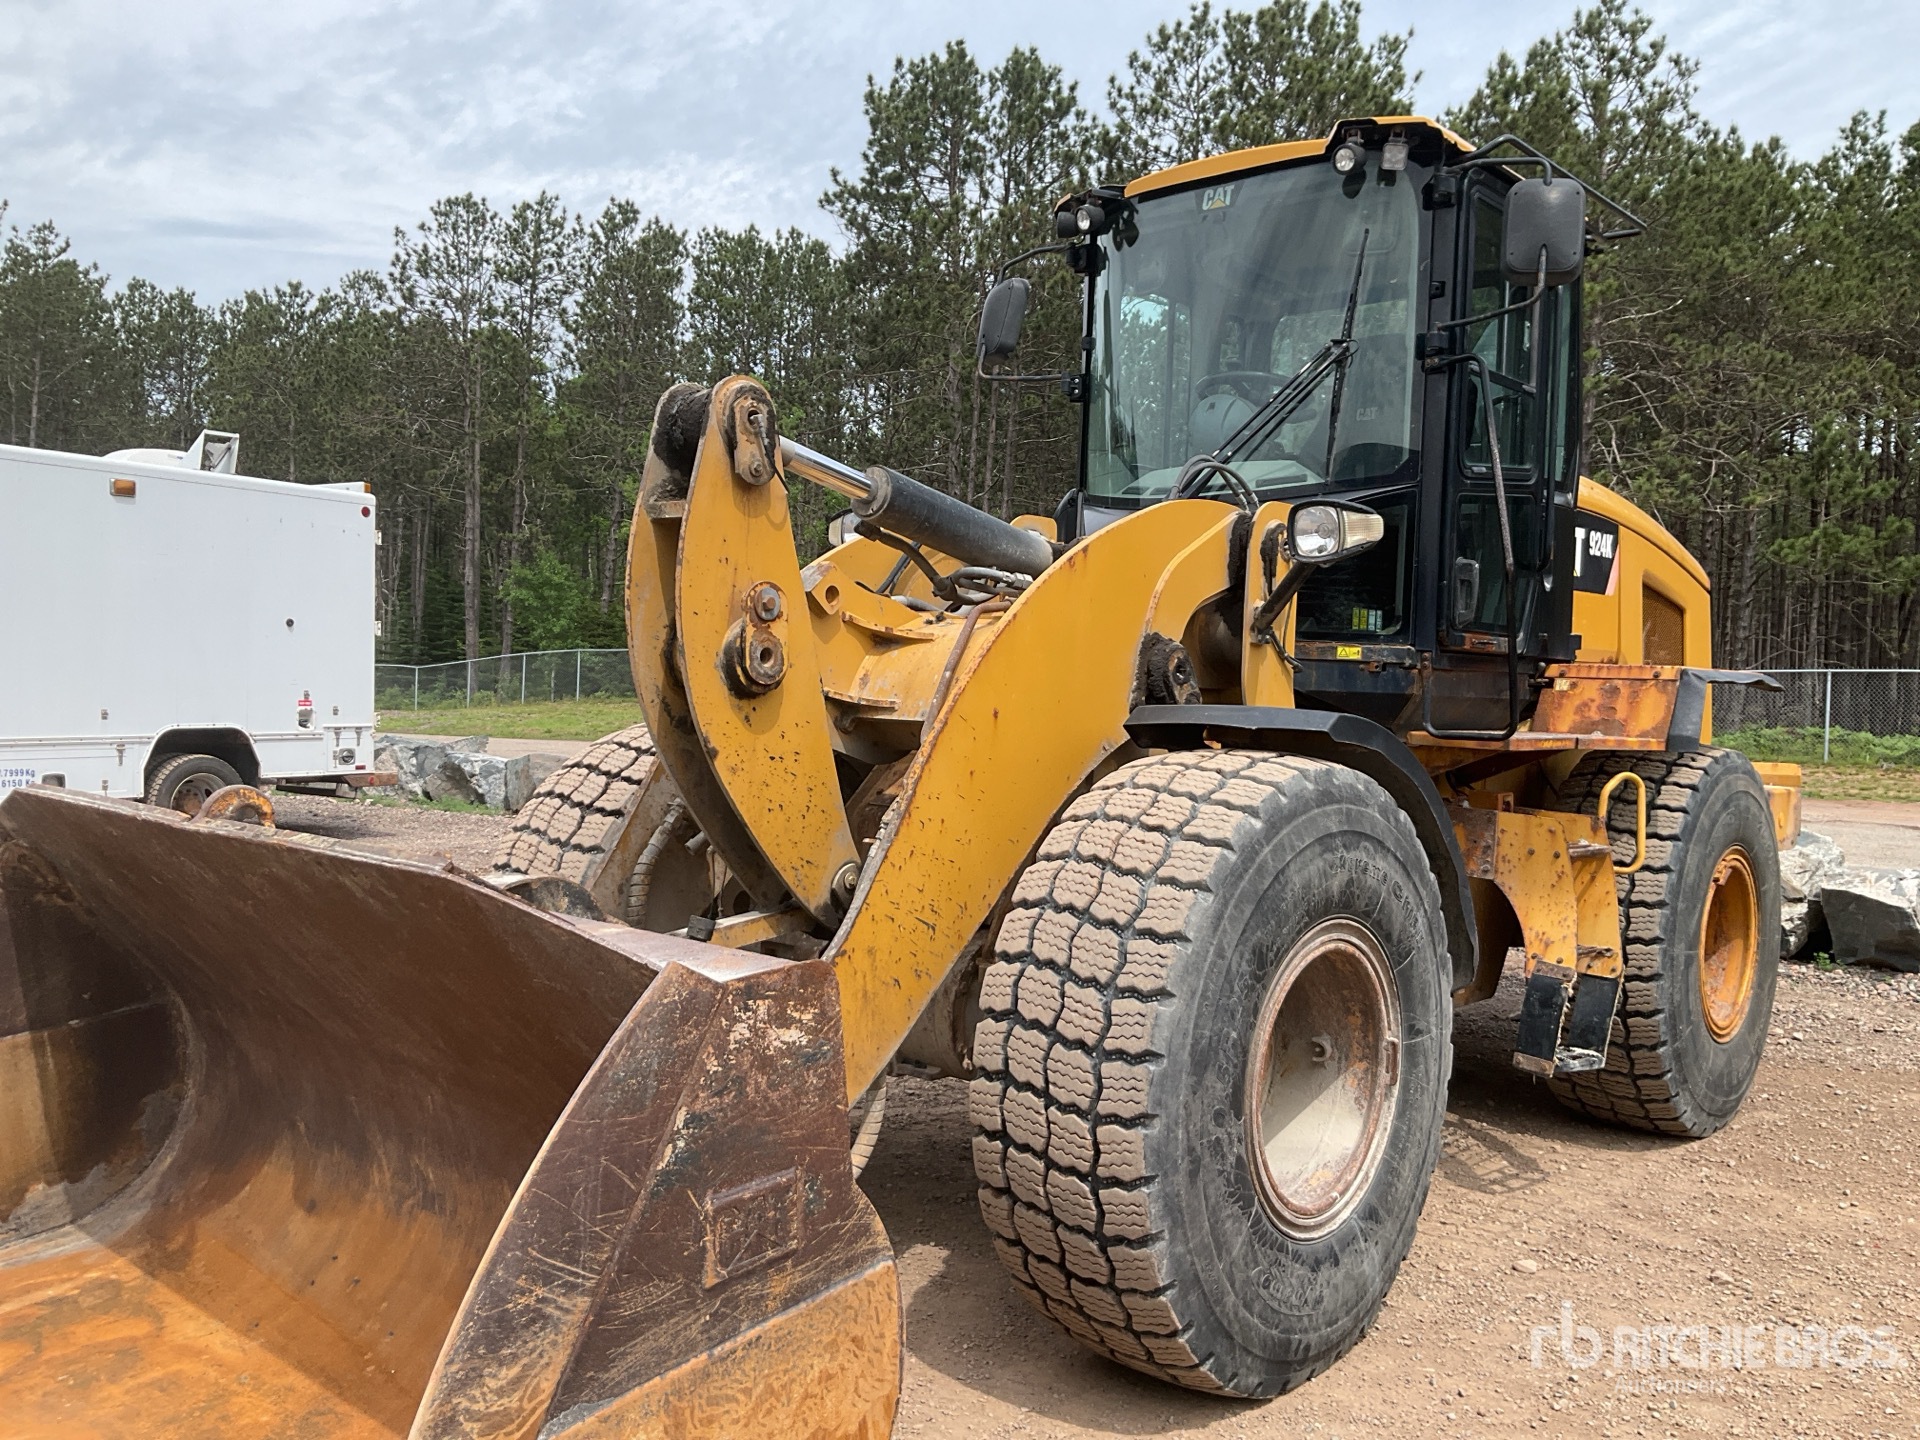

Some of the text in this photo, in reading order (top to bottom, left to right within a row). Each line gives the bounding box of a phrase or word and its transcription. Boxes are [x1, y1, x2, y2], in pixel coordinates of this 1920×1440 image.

[1202, 184, 1235, 210] CAT
[1356, 406, 1378, 421] CAT
[1589, 530, 1613, 558] 924K
